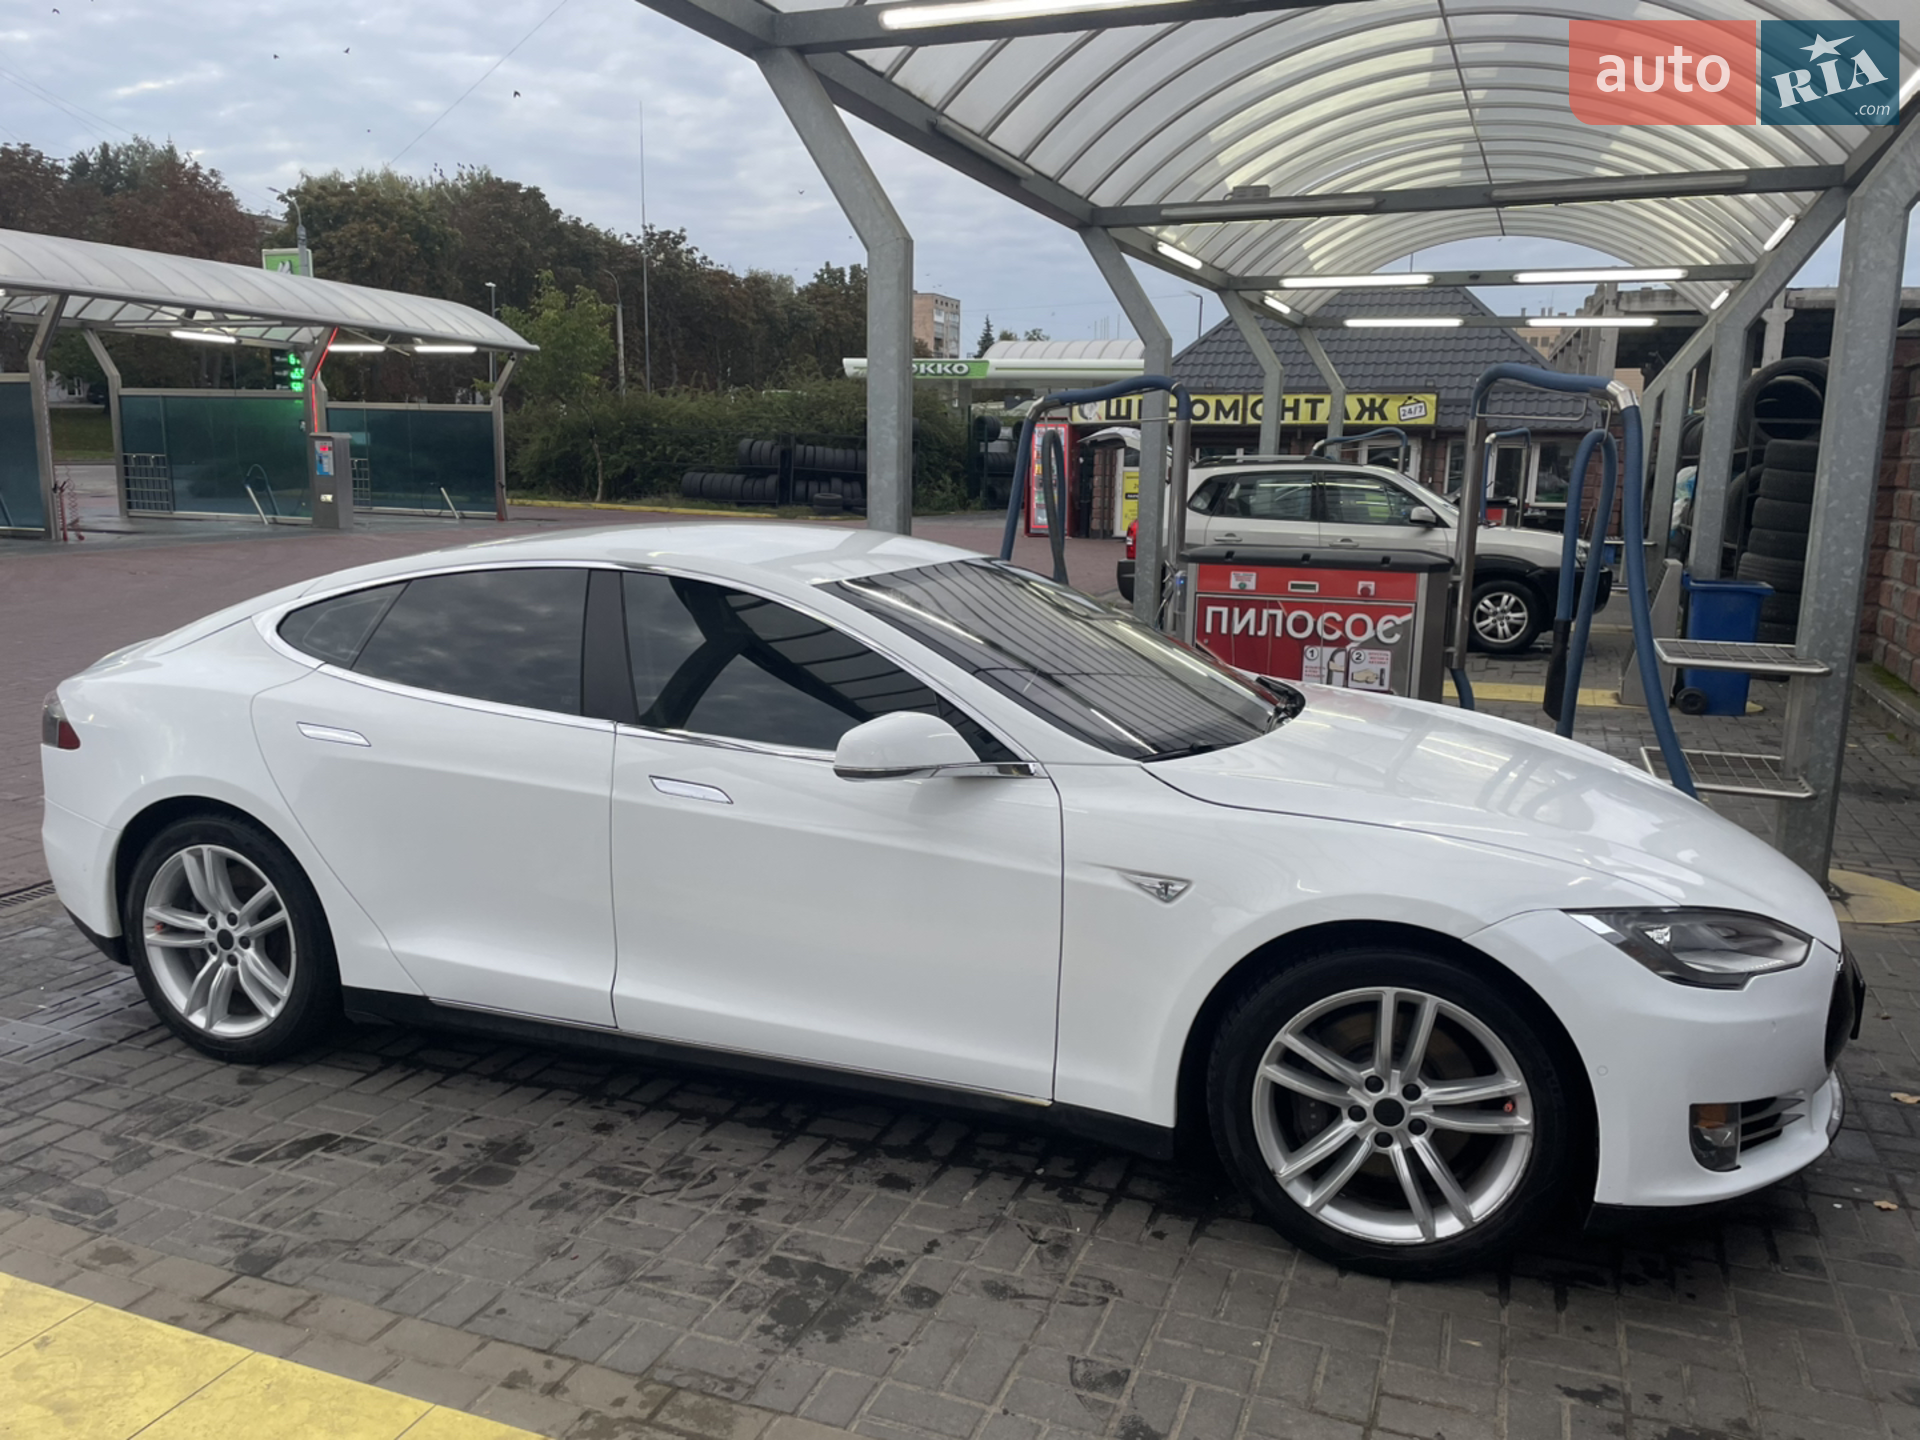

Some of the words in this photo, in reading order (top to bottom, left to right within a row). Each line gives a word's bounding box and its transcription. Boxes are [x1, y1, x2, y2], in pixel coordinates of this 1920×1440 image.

[1401, 405, 1425, 418] 24/7
[1205, 605, 1403, 645] ПИЛОСОС
[1308, 649, 1315, 658] 1
[1355, 652, 1363, 661] 2
